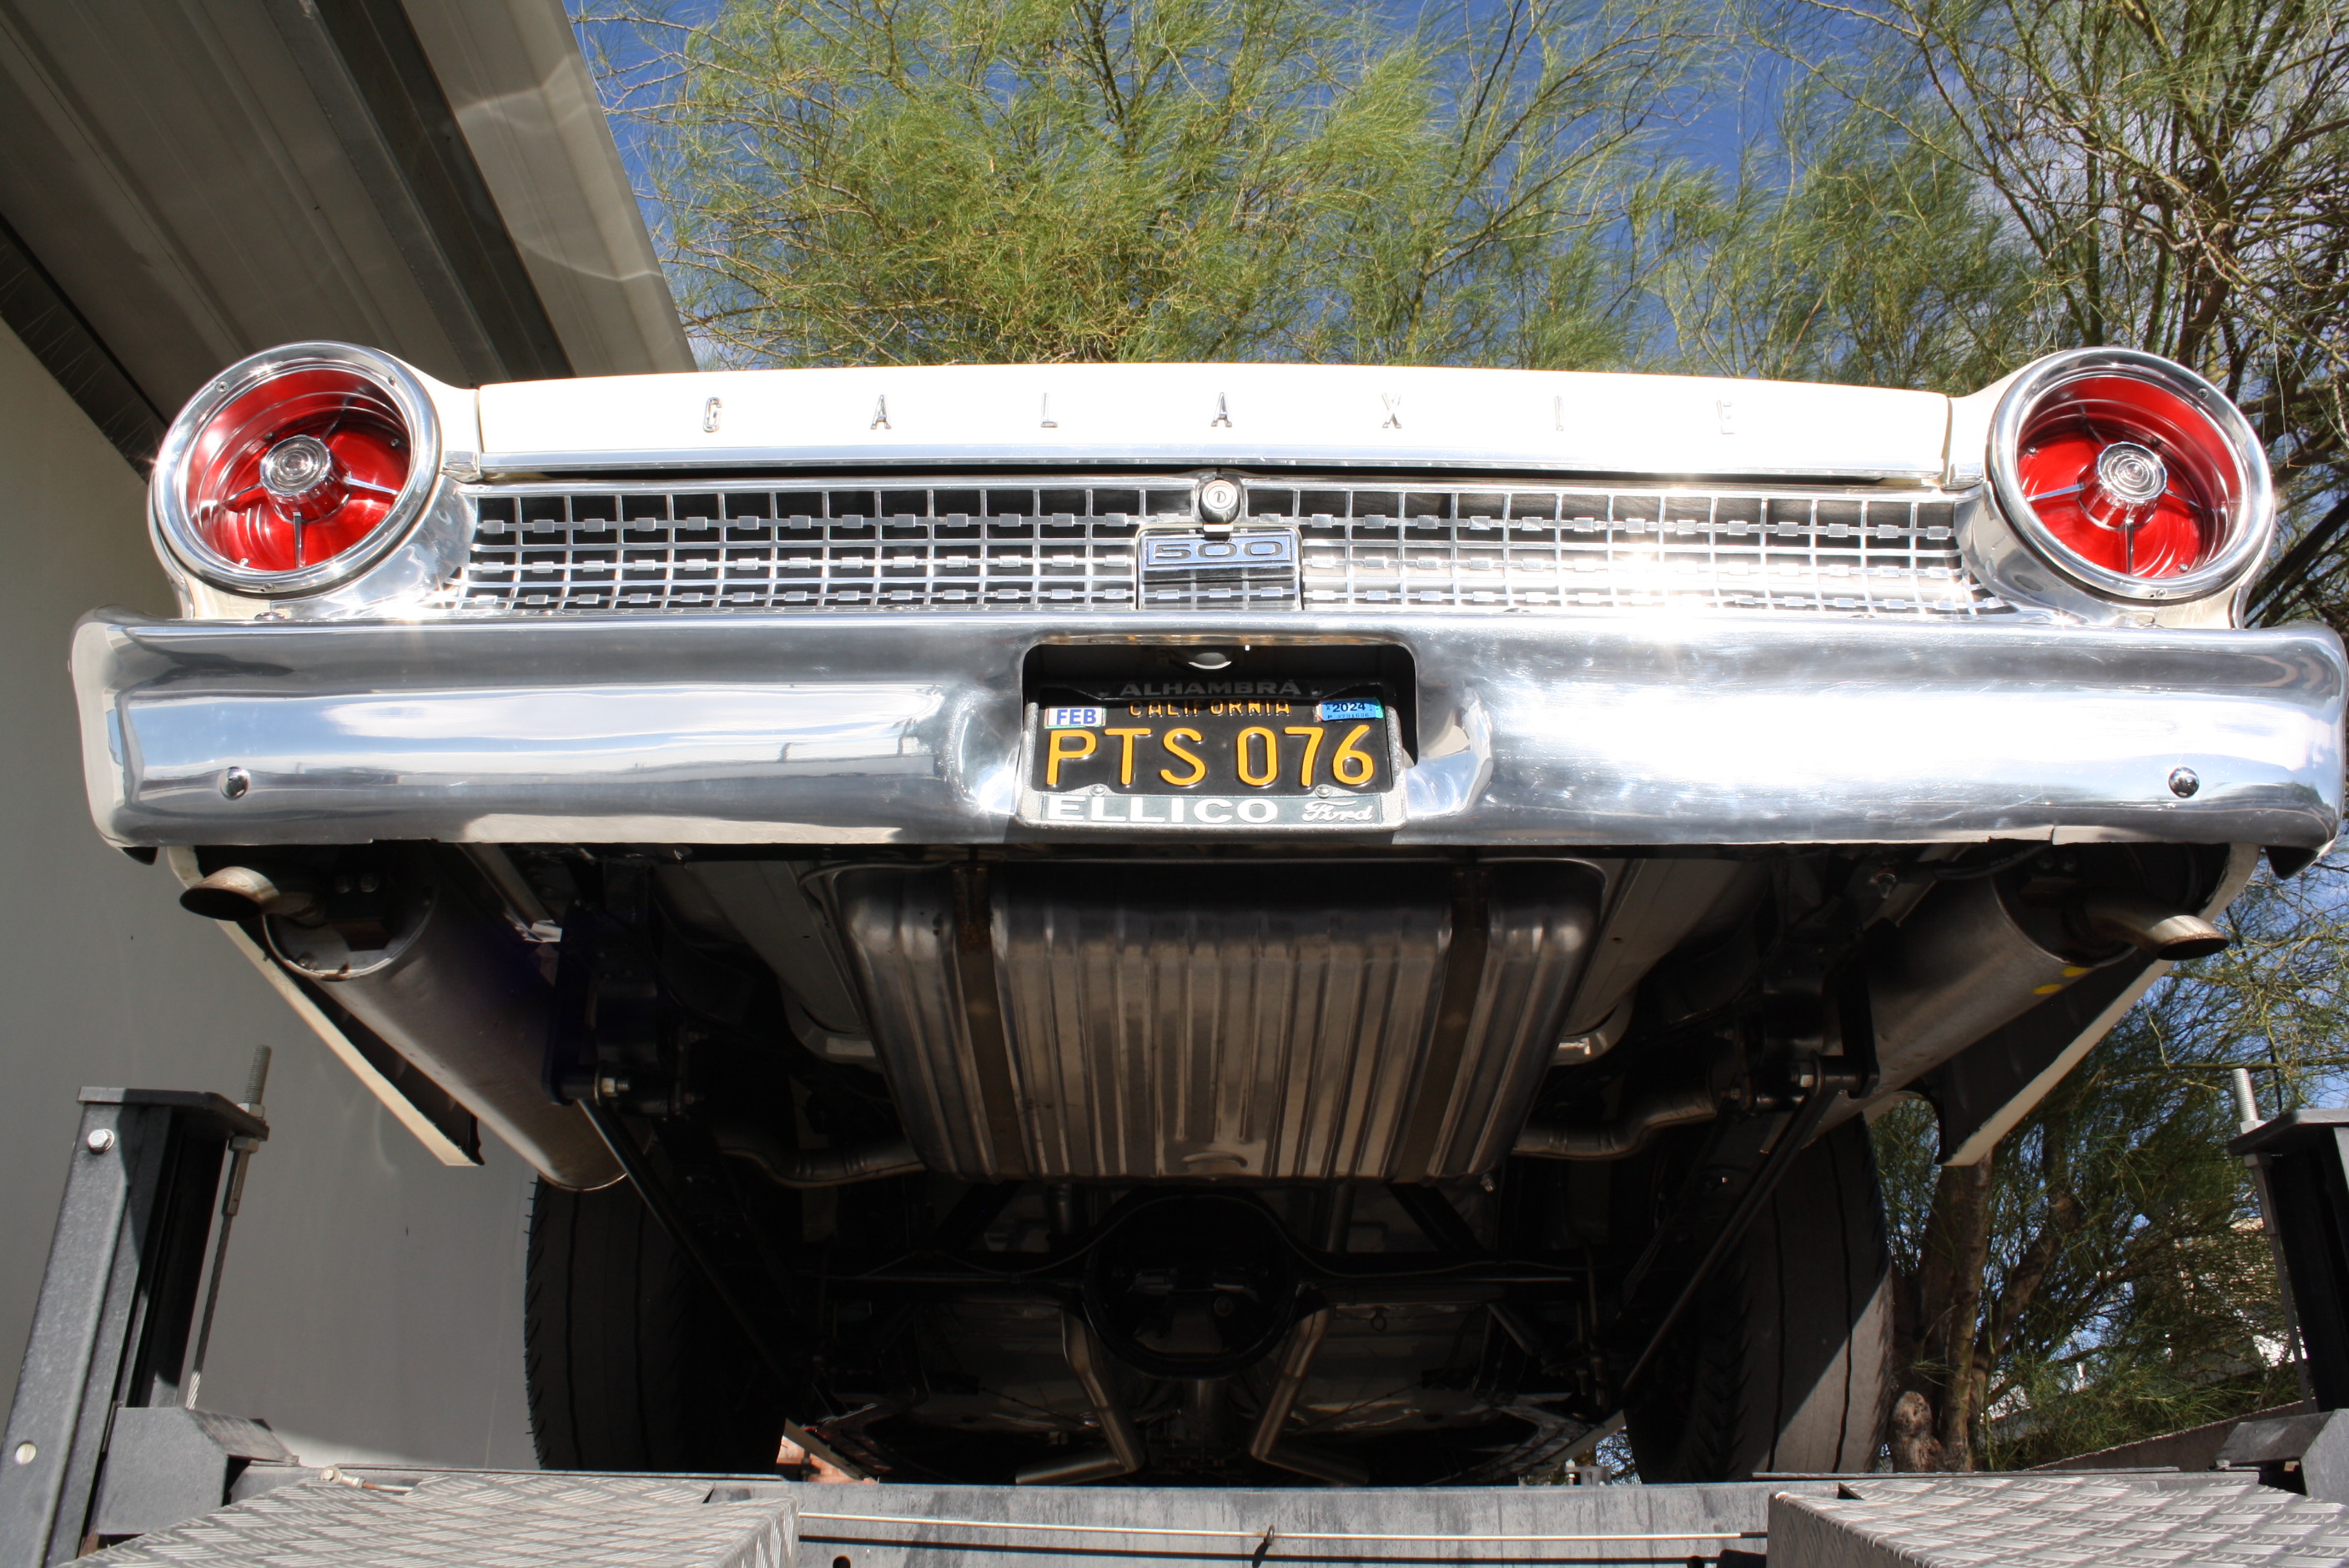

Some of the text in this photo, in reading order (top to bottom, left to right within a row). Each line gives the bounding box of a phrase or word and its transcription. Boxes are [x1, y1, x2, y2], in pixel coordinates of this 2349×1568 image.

[702, 392, 1736, 435] GALAXIE
[1154, 541, 1283, 560] 500
[1119, 681, 1302, 696] ALHAMBRA
[1129, 700, 1290, 716] CALIFORNIA
[1332, 702, 1366, 712] 2024
[1056, 708, 1097, 725] FEB
[1046, 725, 1375, 787] PTS 076
[1047, 796, 1373, 823] ELLICO Ford
